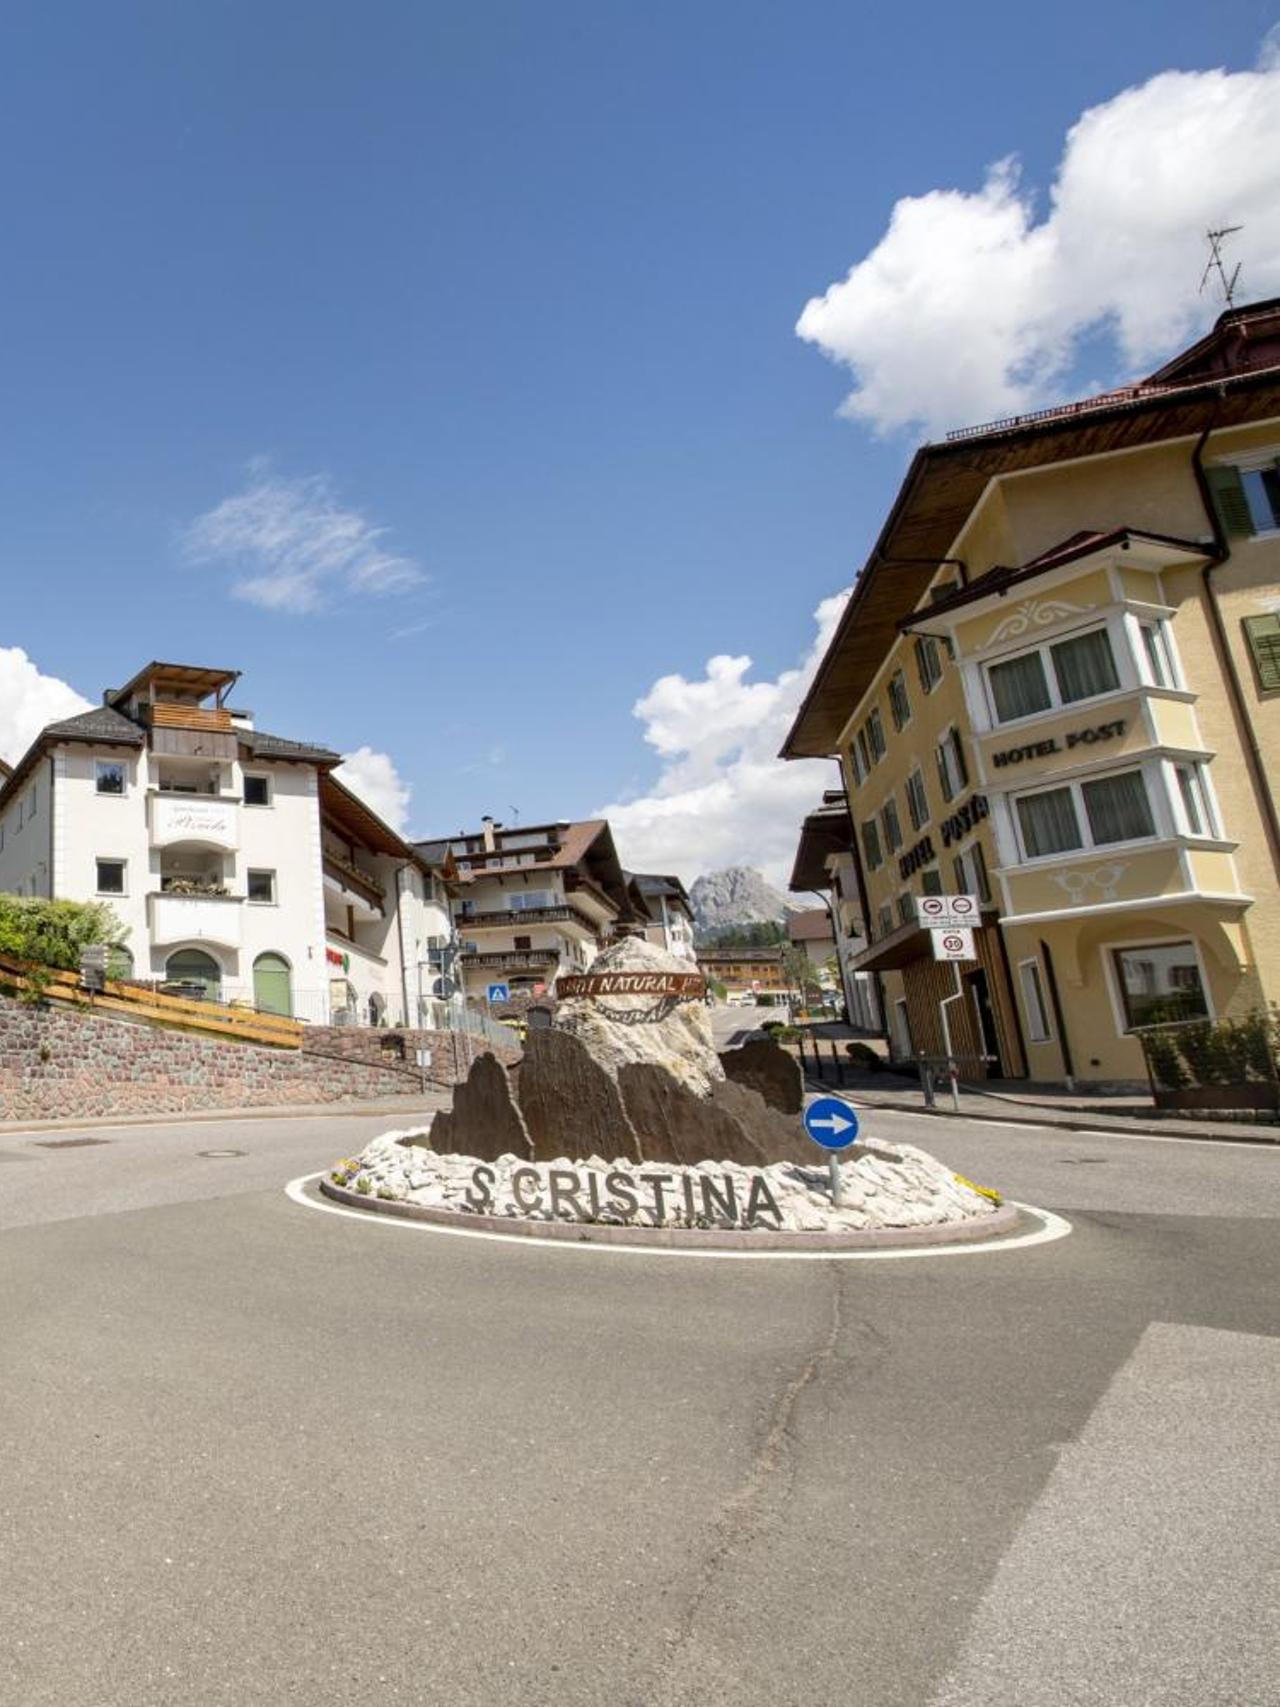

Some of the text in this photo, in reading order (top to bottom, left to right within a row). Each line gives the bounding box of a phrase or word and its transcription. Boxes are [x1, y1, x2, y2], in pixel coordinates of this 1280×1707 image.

[992, 719, 1126, 768] HOTEL POST
[599, 974, 677, 992] NATURAL
[511, 1166, 785, 1224] CRISTINA
